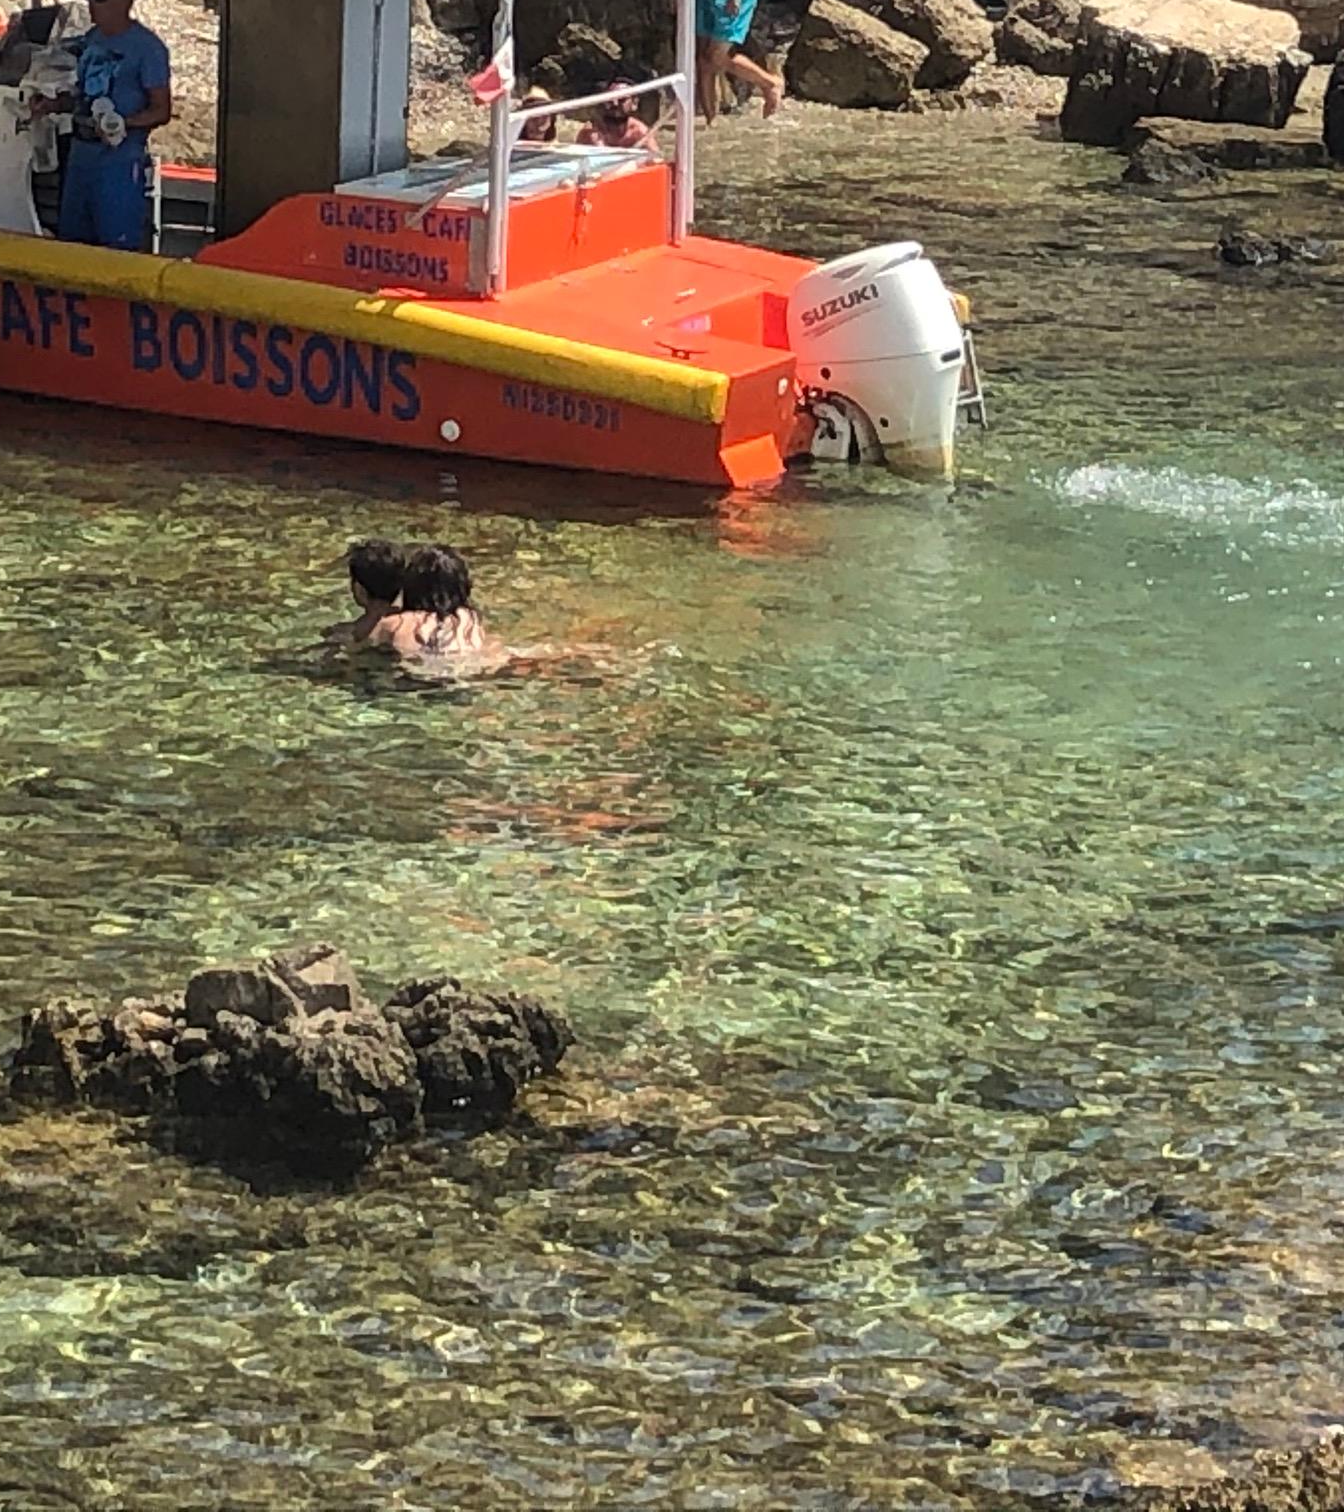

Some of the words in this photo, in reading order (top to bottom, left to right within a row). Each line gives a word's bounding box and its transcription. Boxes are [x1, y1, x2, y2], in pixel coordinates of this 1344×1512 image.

[320, 200, 397, 234] GLACES
[344, 241, 449, 284] BOISSONS
[800, 283, 879, 327] SUZUKI
[129, 299, 421, 422] BOISSONS
